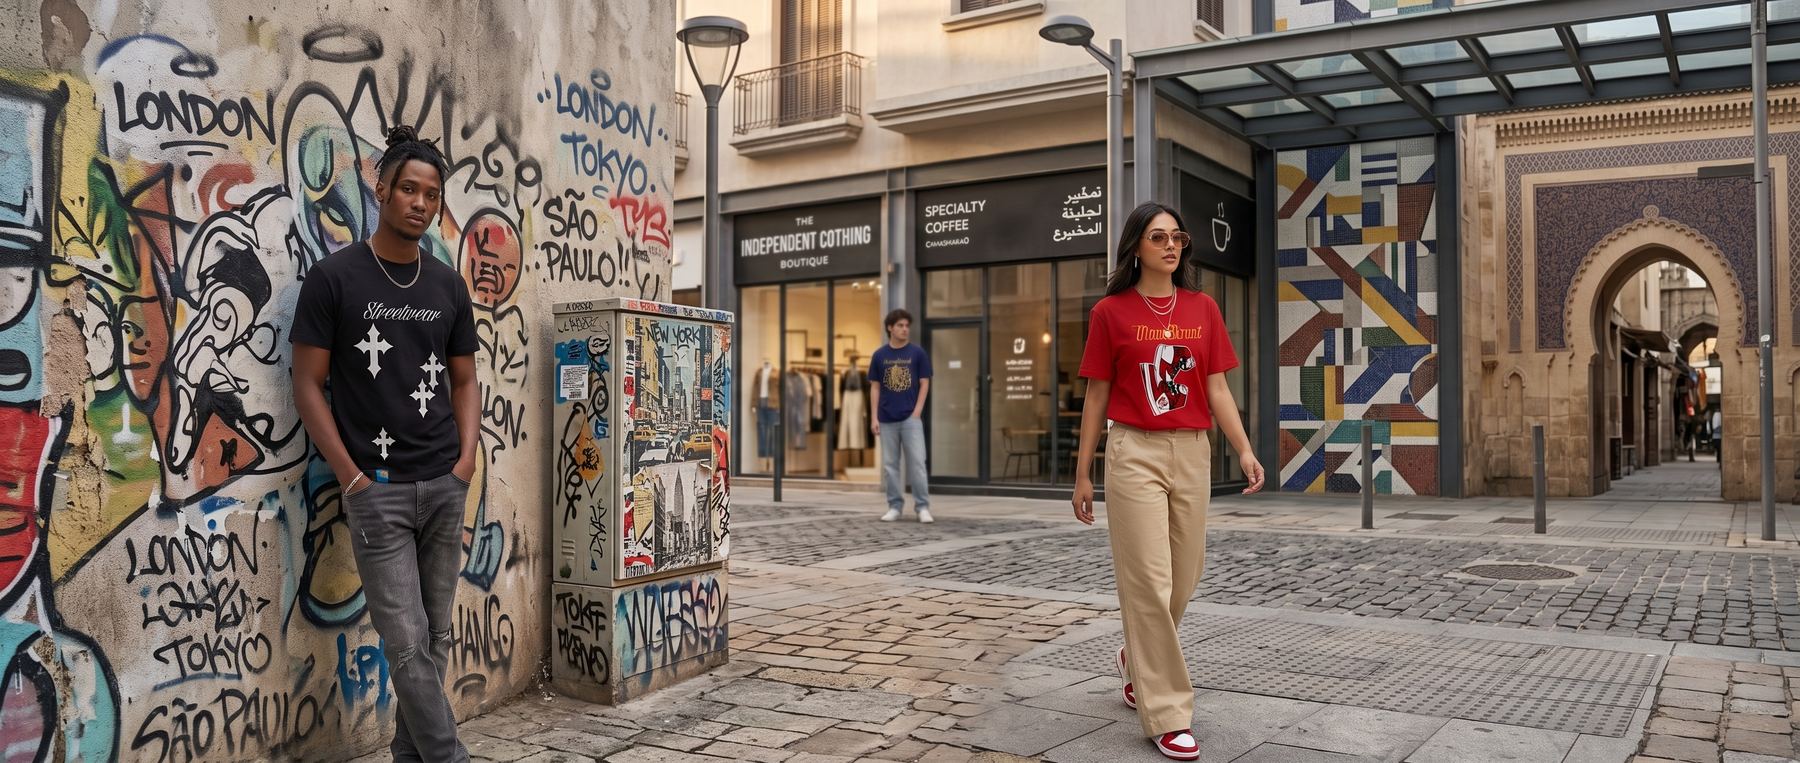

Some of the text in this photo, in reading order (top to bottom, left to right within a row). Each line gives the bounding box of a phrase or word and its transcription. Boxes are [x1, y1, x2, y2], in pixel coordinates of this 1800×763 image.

[114, 82, 277, 145] LONDON
[543, 188, 598, 241] SÃO
[925, 200, 986, 217] SPECIALTY
[795, 216, 814, 226] THE
[925, 219, 969, 234] COFFEE
[741, 225, 871, 257] INDEPENDENT COTHING
[780, 256, 829, 269] BOUTIQUE
[363, 301, 442, 321] Streetwear
[672, 324, 701, 345] YORK
[153, 632, 272, 680] TOKYO
[131, 687, 318, 763] SÃO PAULO
